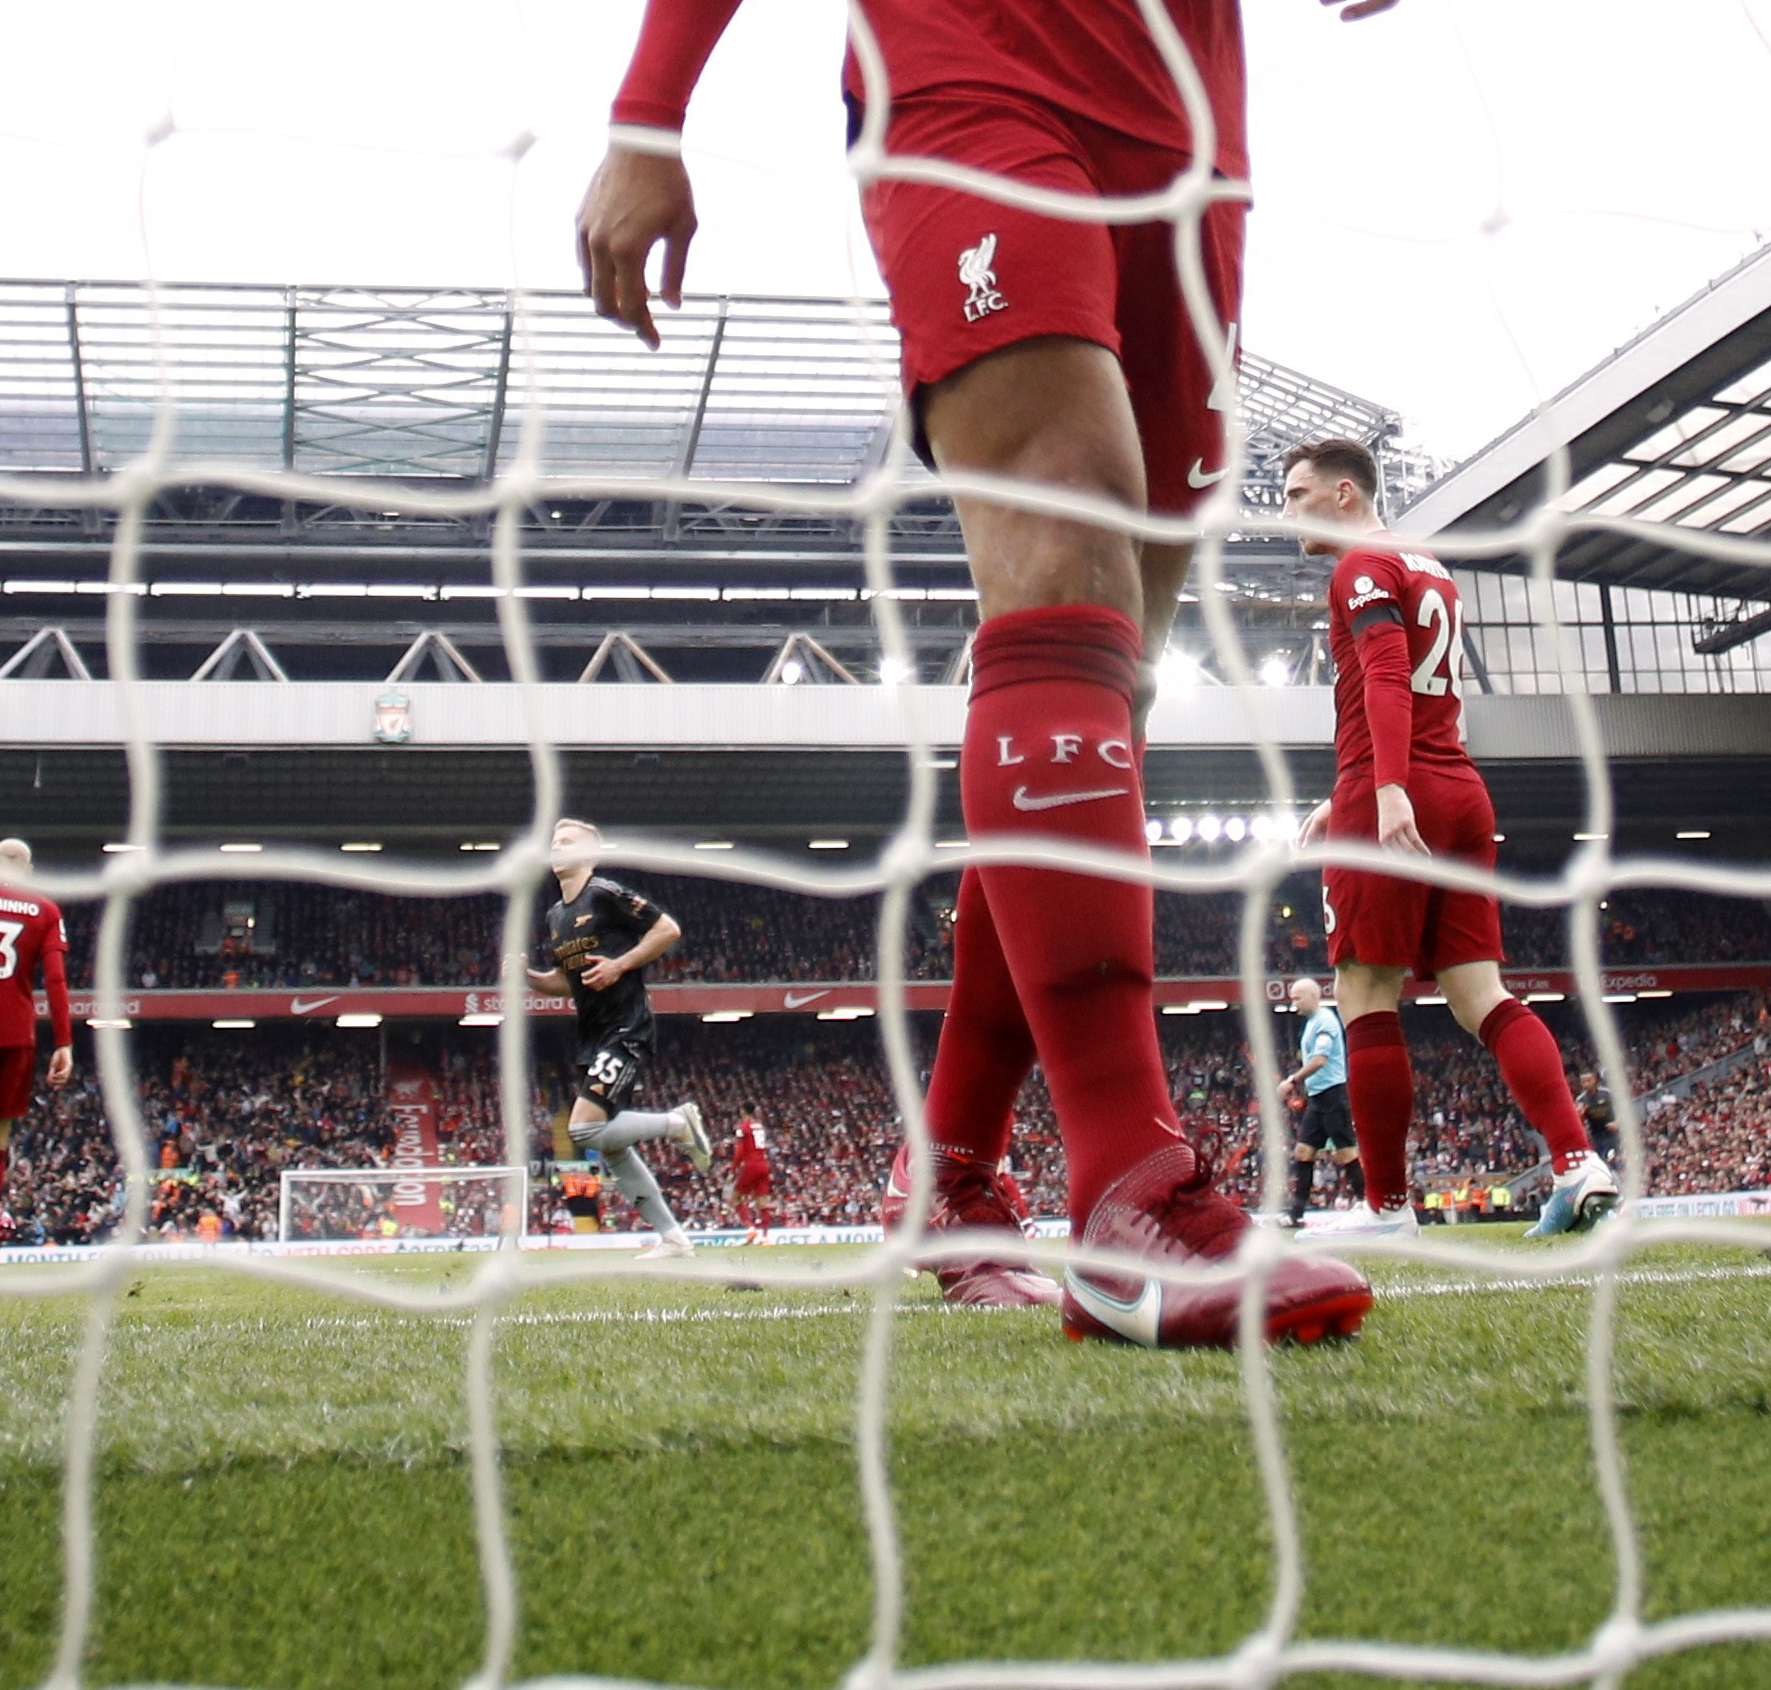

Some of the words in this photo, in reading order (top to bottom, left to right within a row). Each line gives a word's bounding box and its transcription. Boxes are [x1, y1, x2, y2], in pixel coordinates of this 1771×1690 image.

[1347, 587, 1390, 611] Expedia
[483, 994, 564, 1011] stadard
[587, 1050, 624, 1085] 35
[387, 1104, 435, 1207] Foundaon
[835, 1232, 884, 1244] MON
